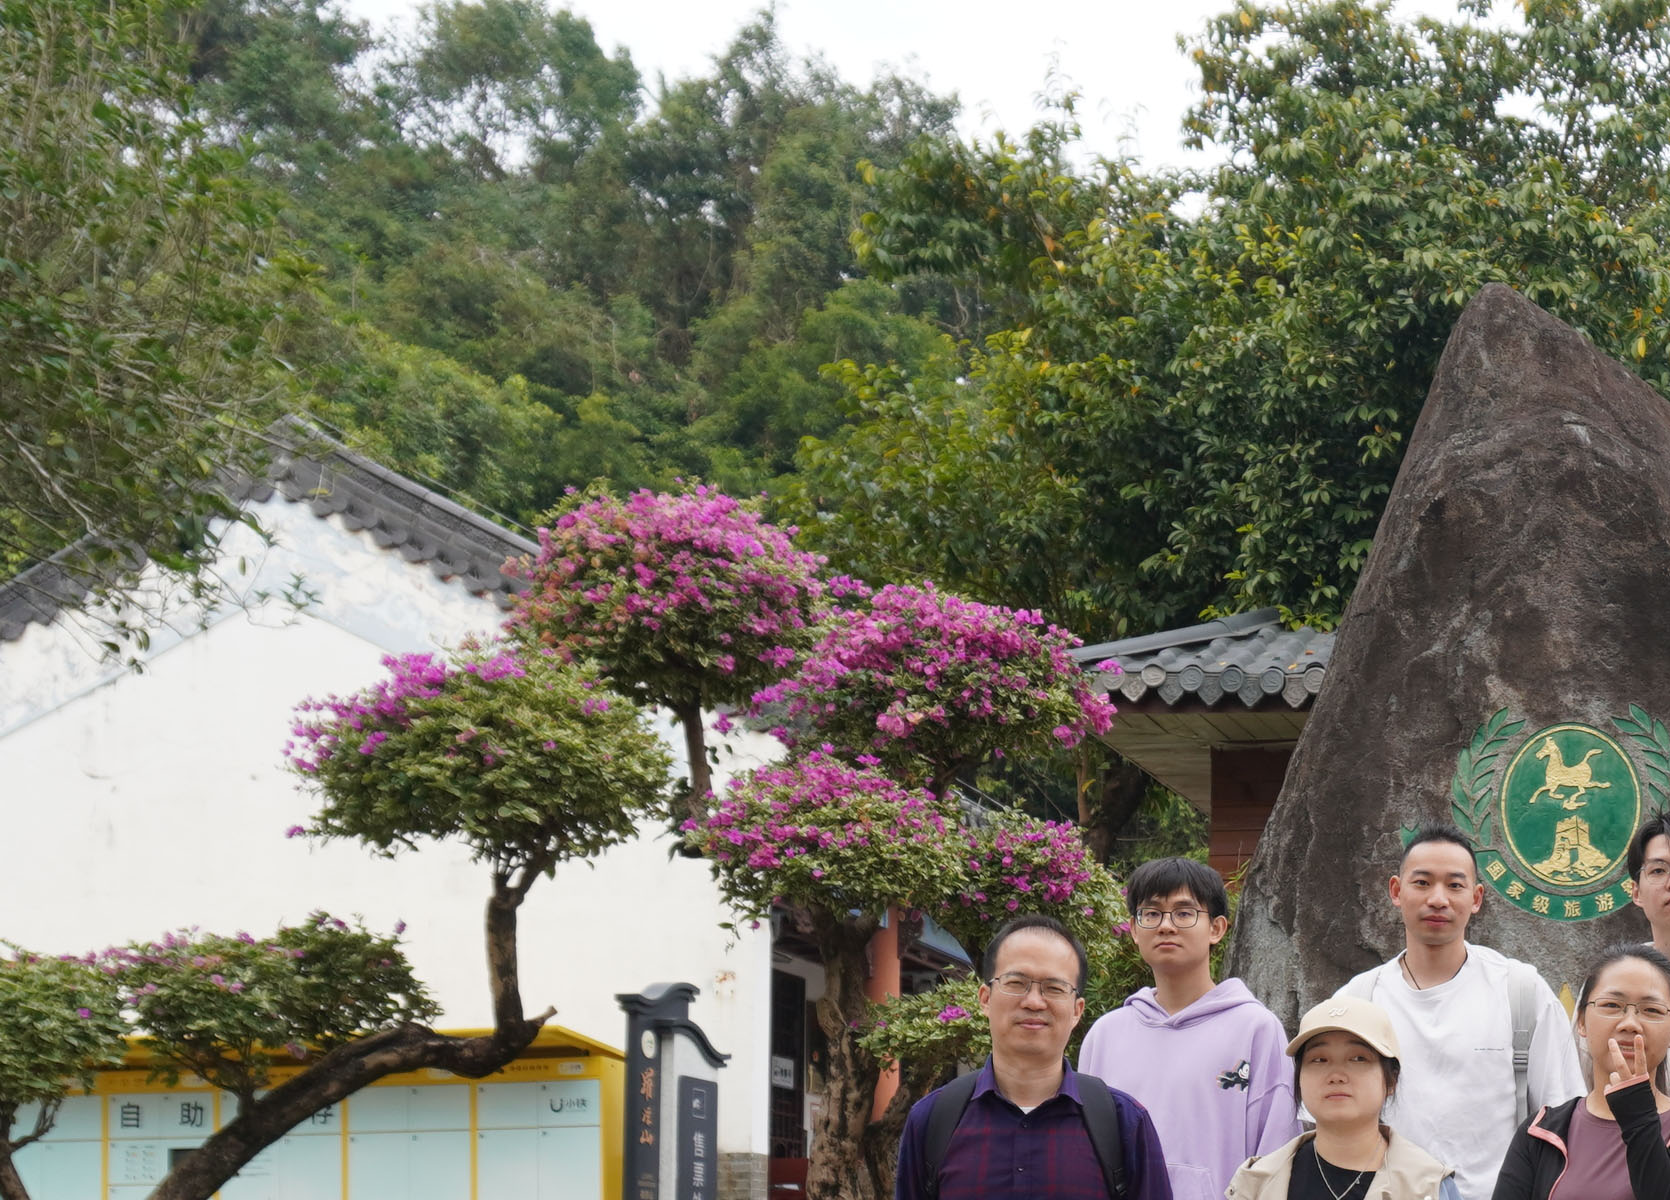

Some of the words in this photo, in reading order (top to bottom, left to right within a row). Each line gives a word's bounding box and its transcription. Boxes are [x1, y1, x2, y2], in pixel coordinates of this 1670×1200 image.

[1485, 859, 1634, 918] 国家级旅游
[120, 1100, 334, 1129] 自助存
